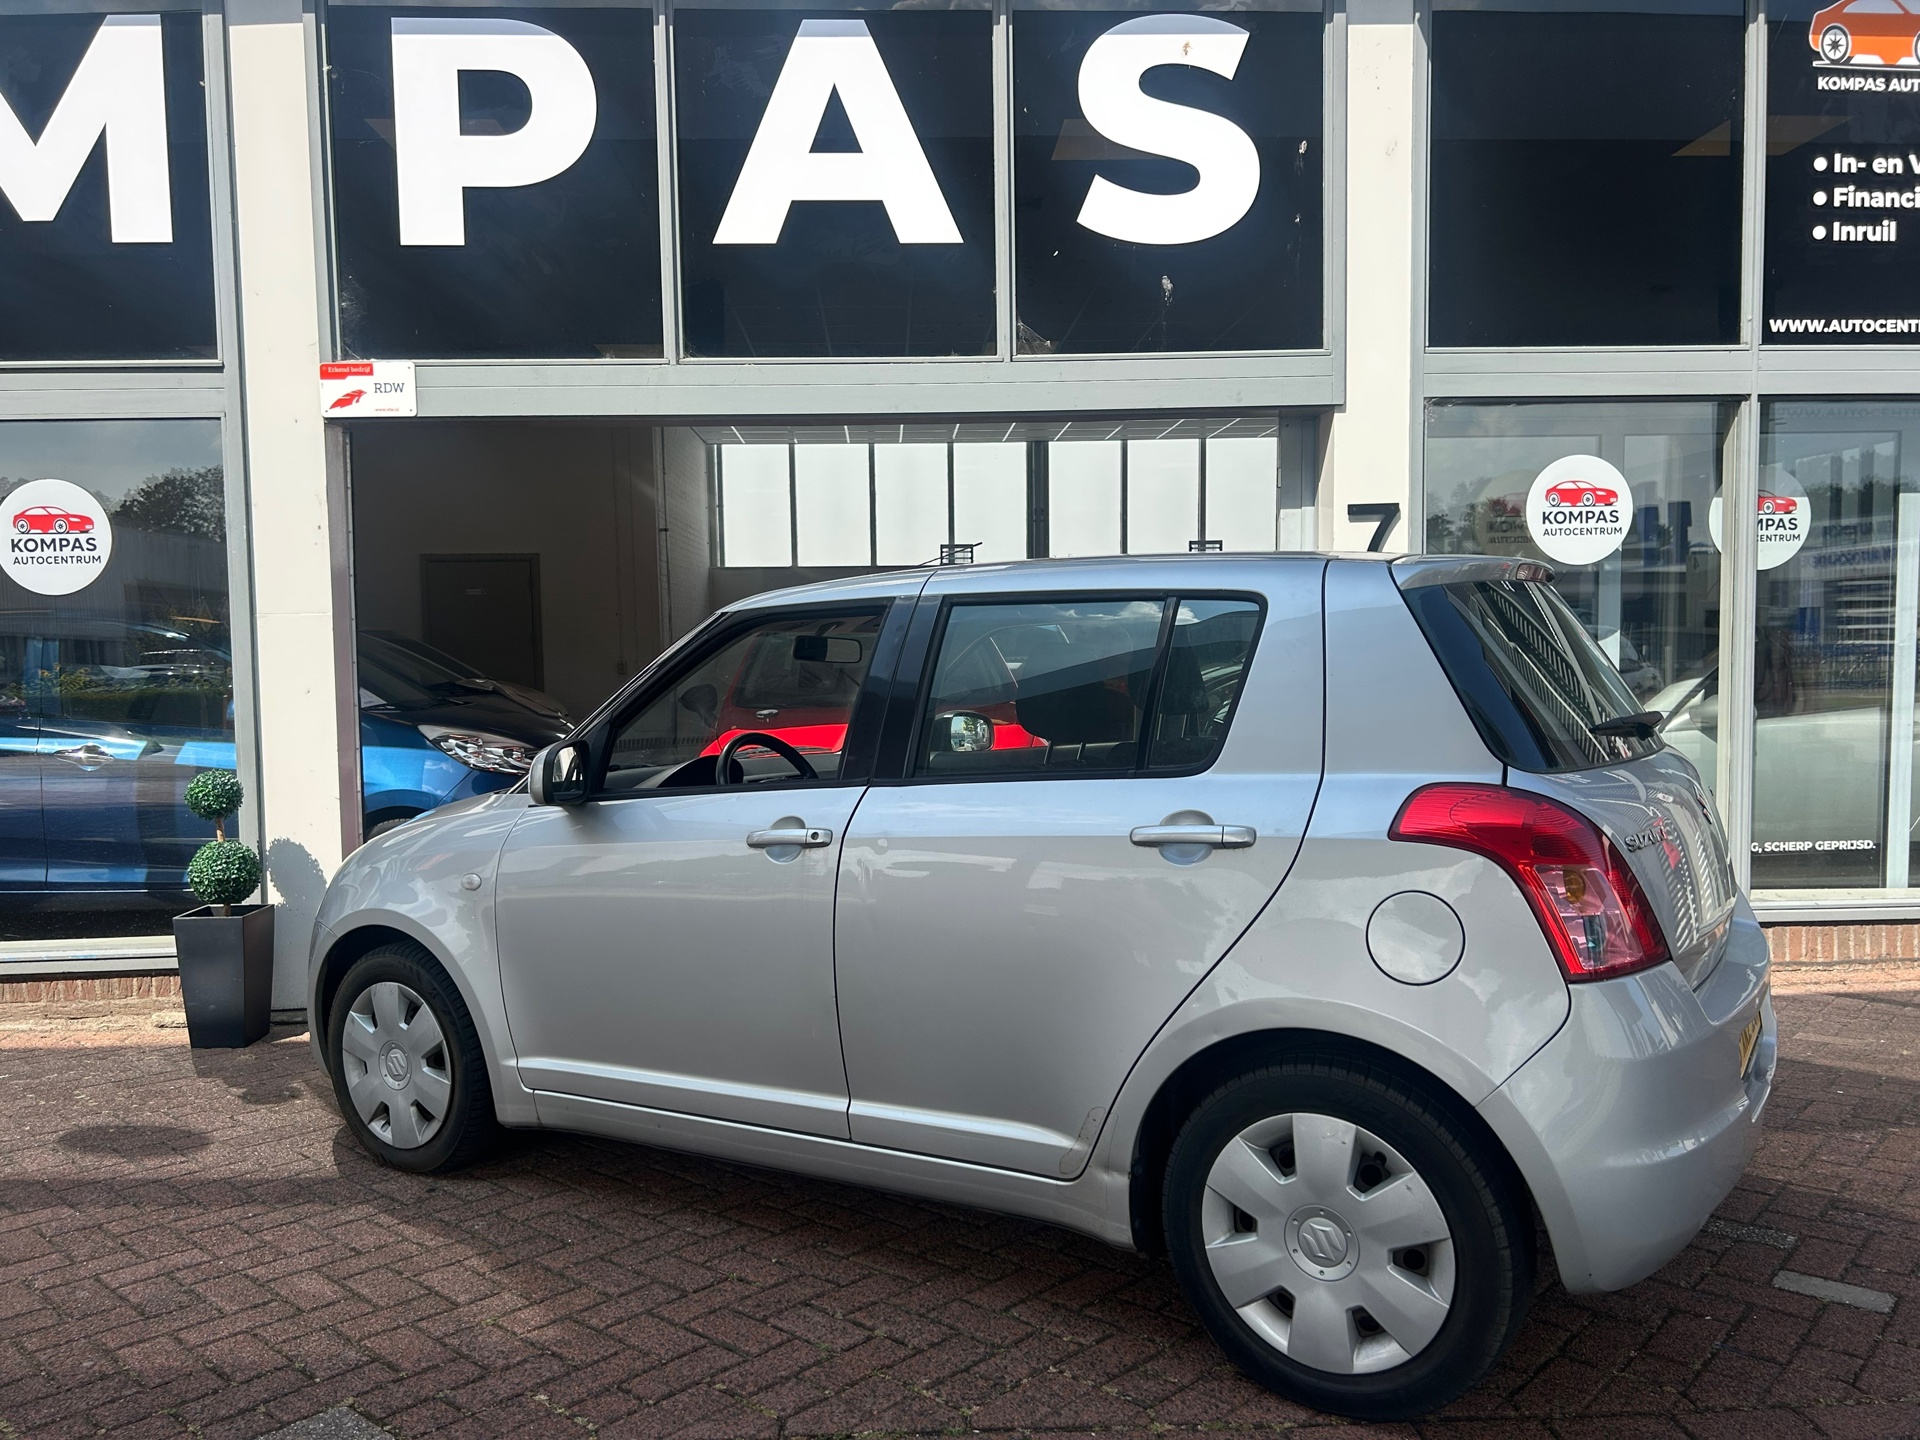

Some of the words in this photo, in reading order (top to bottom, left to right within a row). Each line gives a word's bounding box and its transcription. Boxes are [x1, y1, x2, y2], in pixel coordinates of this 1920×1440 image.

[1817, 76, 1886, 91] KOMPAS
[1887, 78, 1920, 92] AUT
[1833, 153, 1866, 173] In-
[1872, 157, 1903, 174] en
[1833, 184, 1920, 208] Financi
[1832, 219, 1897, 242] Inruil
[1769, 319, 1920, 333] WWW.AUTOCENT
[351, 366, 370, 374] bedrijf
[374, 383, 404, 393] RDW
[1542, 510, 1619, 525] KOMPAS
[1347, 503, 1400, 552] 7
[1542, 526, 1623, 537] AUTOCENTRUM
[11, 537, 97, 552] KOMPAS
[1757, 534, 1801, 542] ENTRUM
[13, 555, 101, 565] AUTOCENTRUM
[1764, 841, 1813, 852] SCHERP
[1815, 839, 1877, 851] GEPRIJSD.
